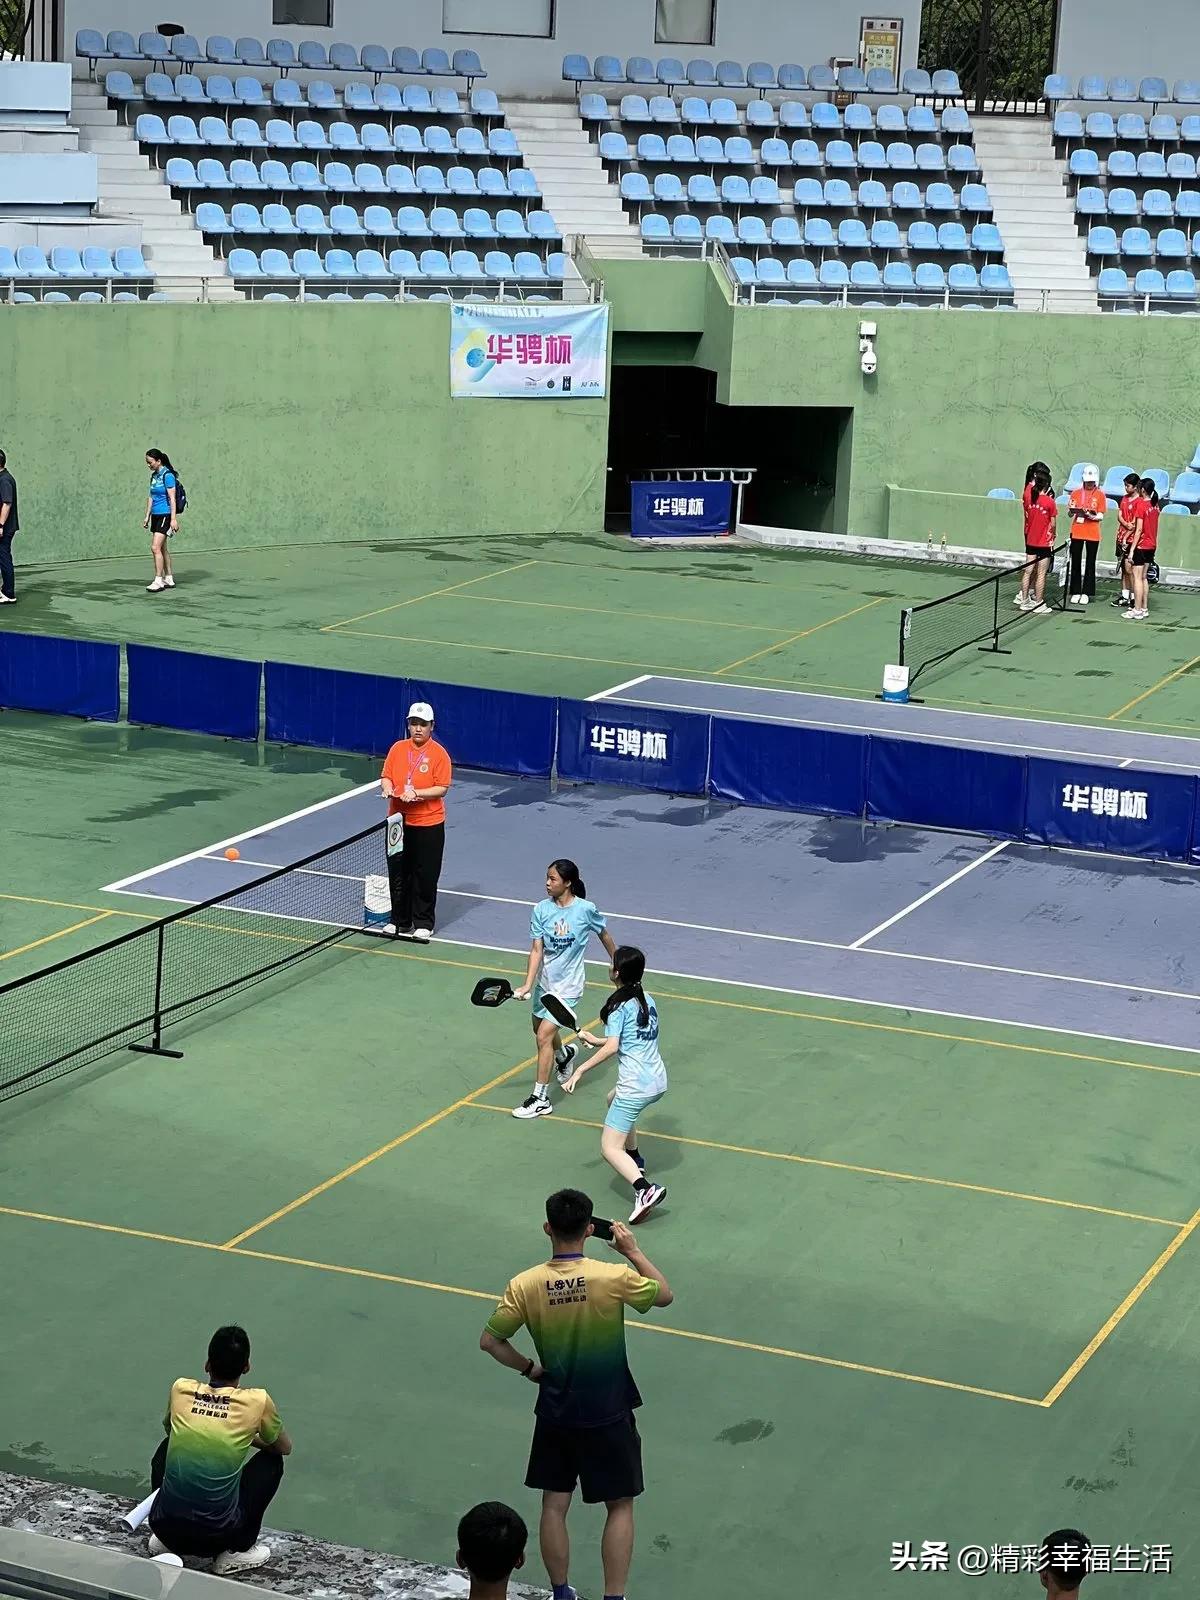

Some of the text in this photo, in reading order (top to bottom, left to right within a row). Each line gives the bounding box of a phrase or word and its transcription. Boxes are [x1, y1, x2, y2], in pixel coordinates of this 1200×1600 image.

[486, 333, 572, 365] 华骋杯
[653, 497, 705, 516] 华骋杯
[590, 725, 668, 760] 华骋杯
[1062, 783, 1148, 820] 华骋杯
[546, 1276, 586, 1291] LOVE
